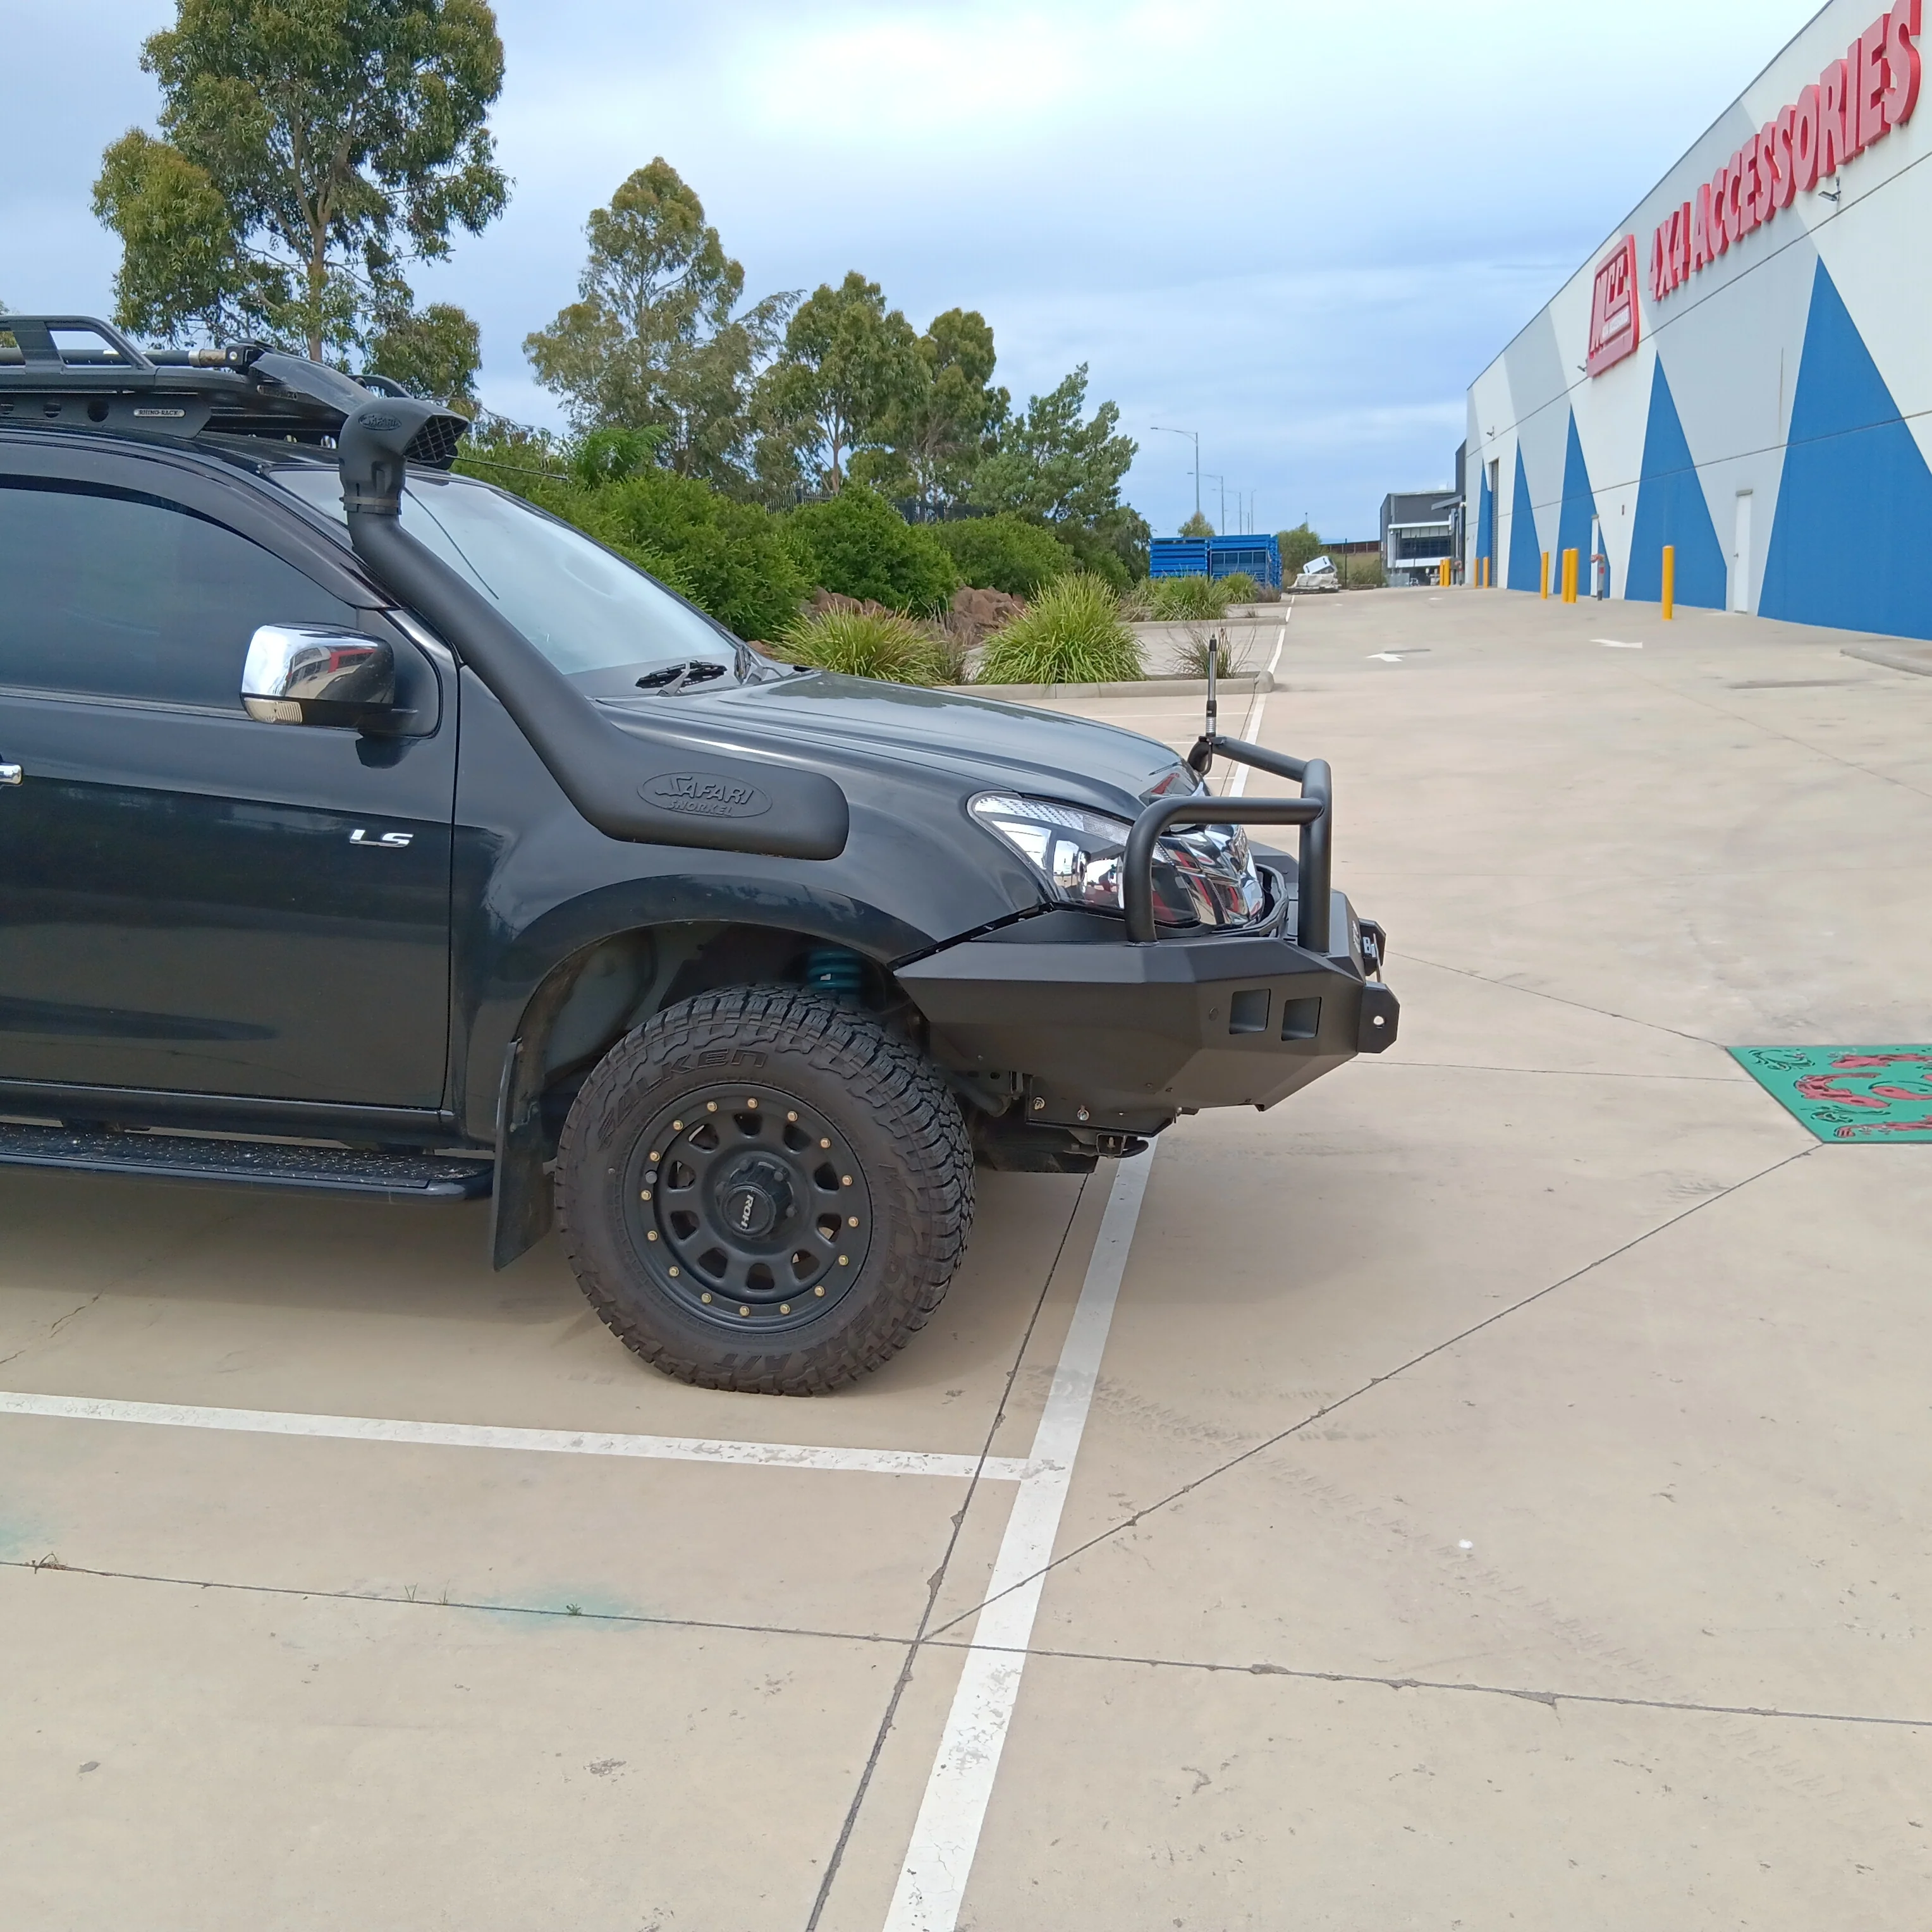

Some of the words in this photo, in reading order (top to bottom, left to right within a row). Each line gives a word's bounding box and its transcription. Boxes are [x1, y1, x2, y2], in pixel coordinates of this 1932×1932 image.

[1648, 201, 1690, 302] 4X4
[1690, 0, 1921, 272] ACCESSORIES
[655, 776, 754, 805] SAFARI
[668, 799, 733, 817] SNORKEL
[349, 829, 414, 848] LS
[741, 1194, 754, 1228] ROH
